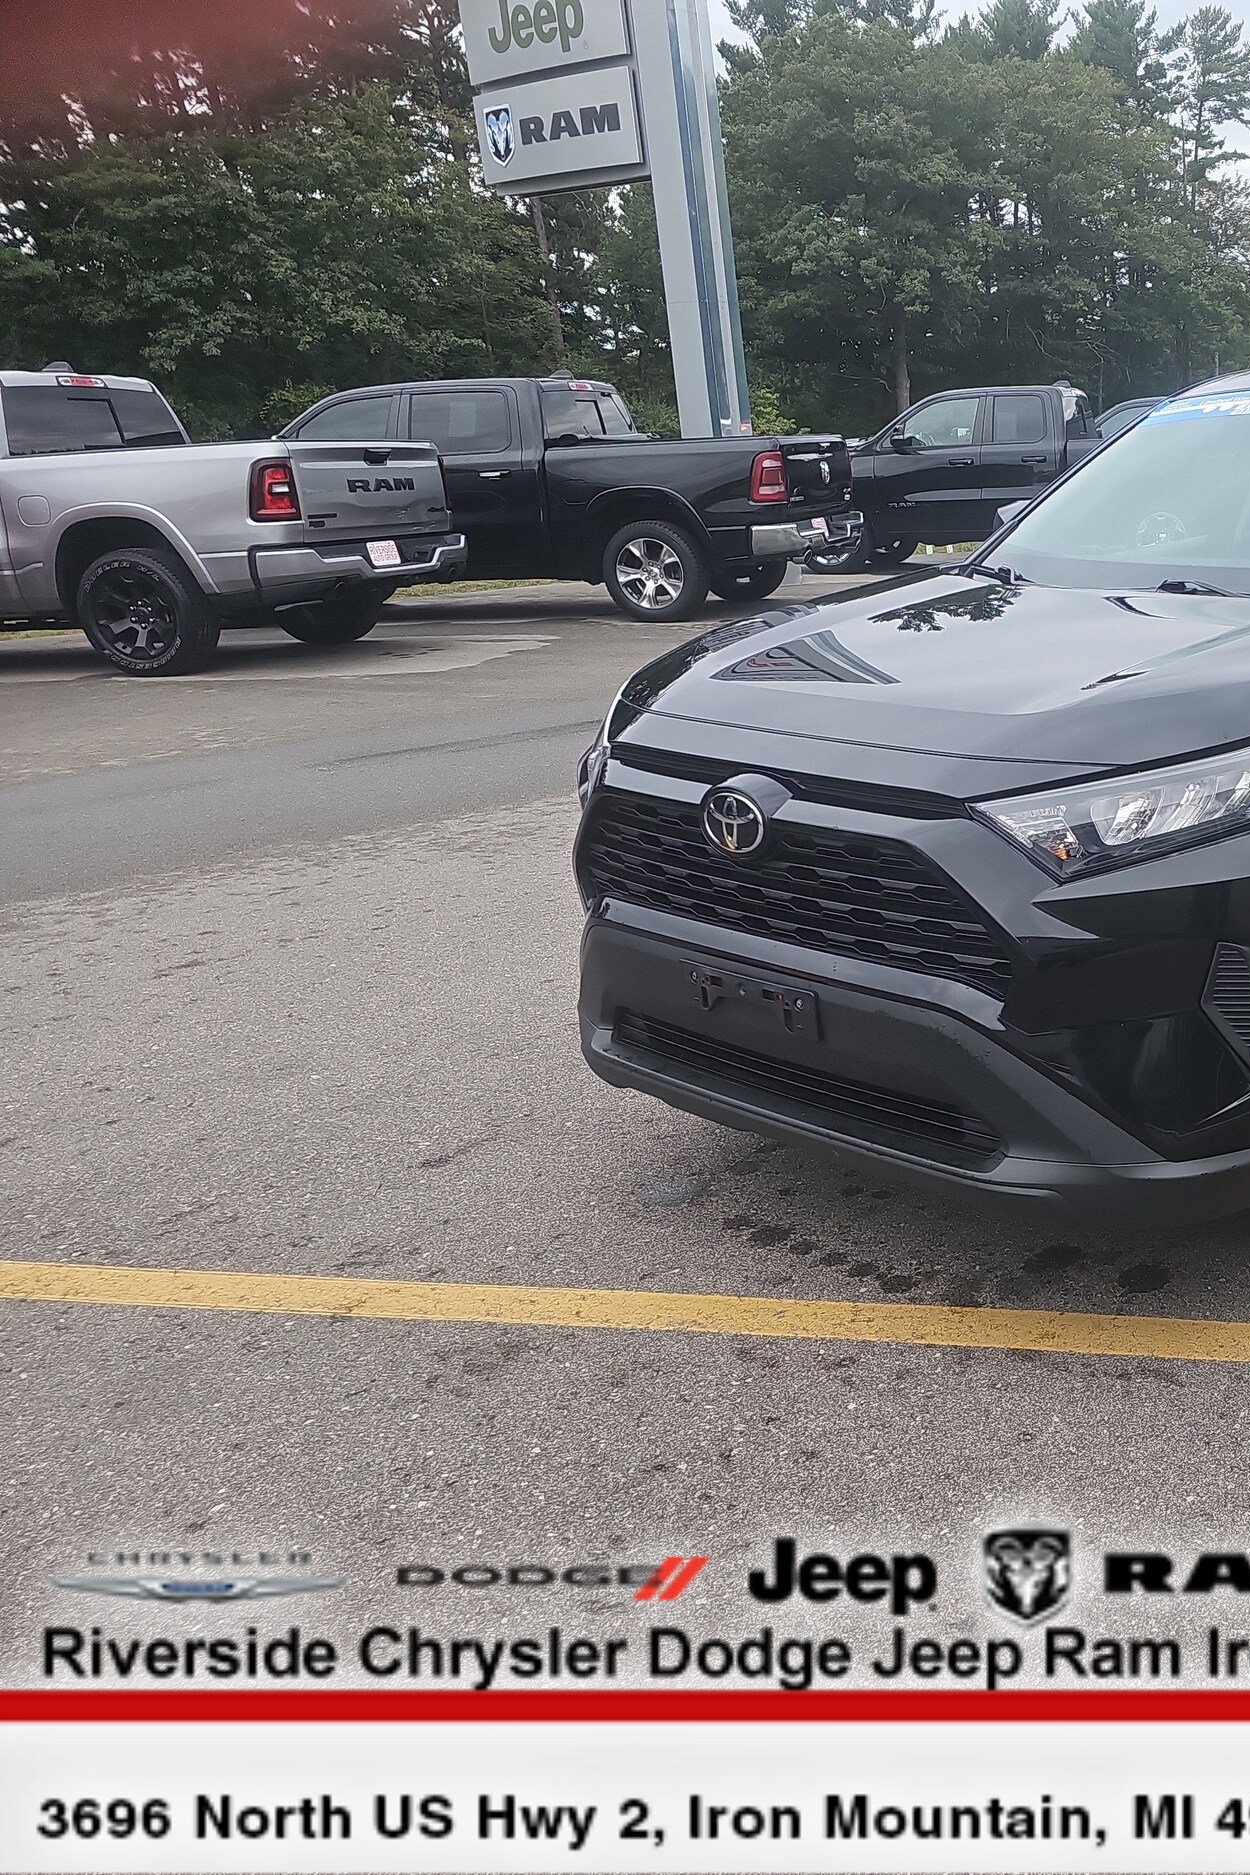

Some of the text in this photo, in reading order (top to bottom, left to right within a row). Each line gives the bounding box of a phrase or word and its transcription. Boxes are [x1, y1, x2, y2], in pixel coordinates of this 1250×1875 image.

[488, 0, 584, 54] Jeep
[519, 102, 621, 146] RAM
[346, 477, 416, 493] RAM
[368, 544, 397, 556] RIVERSIDE
